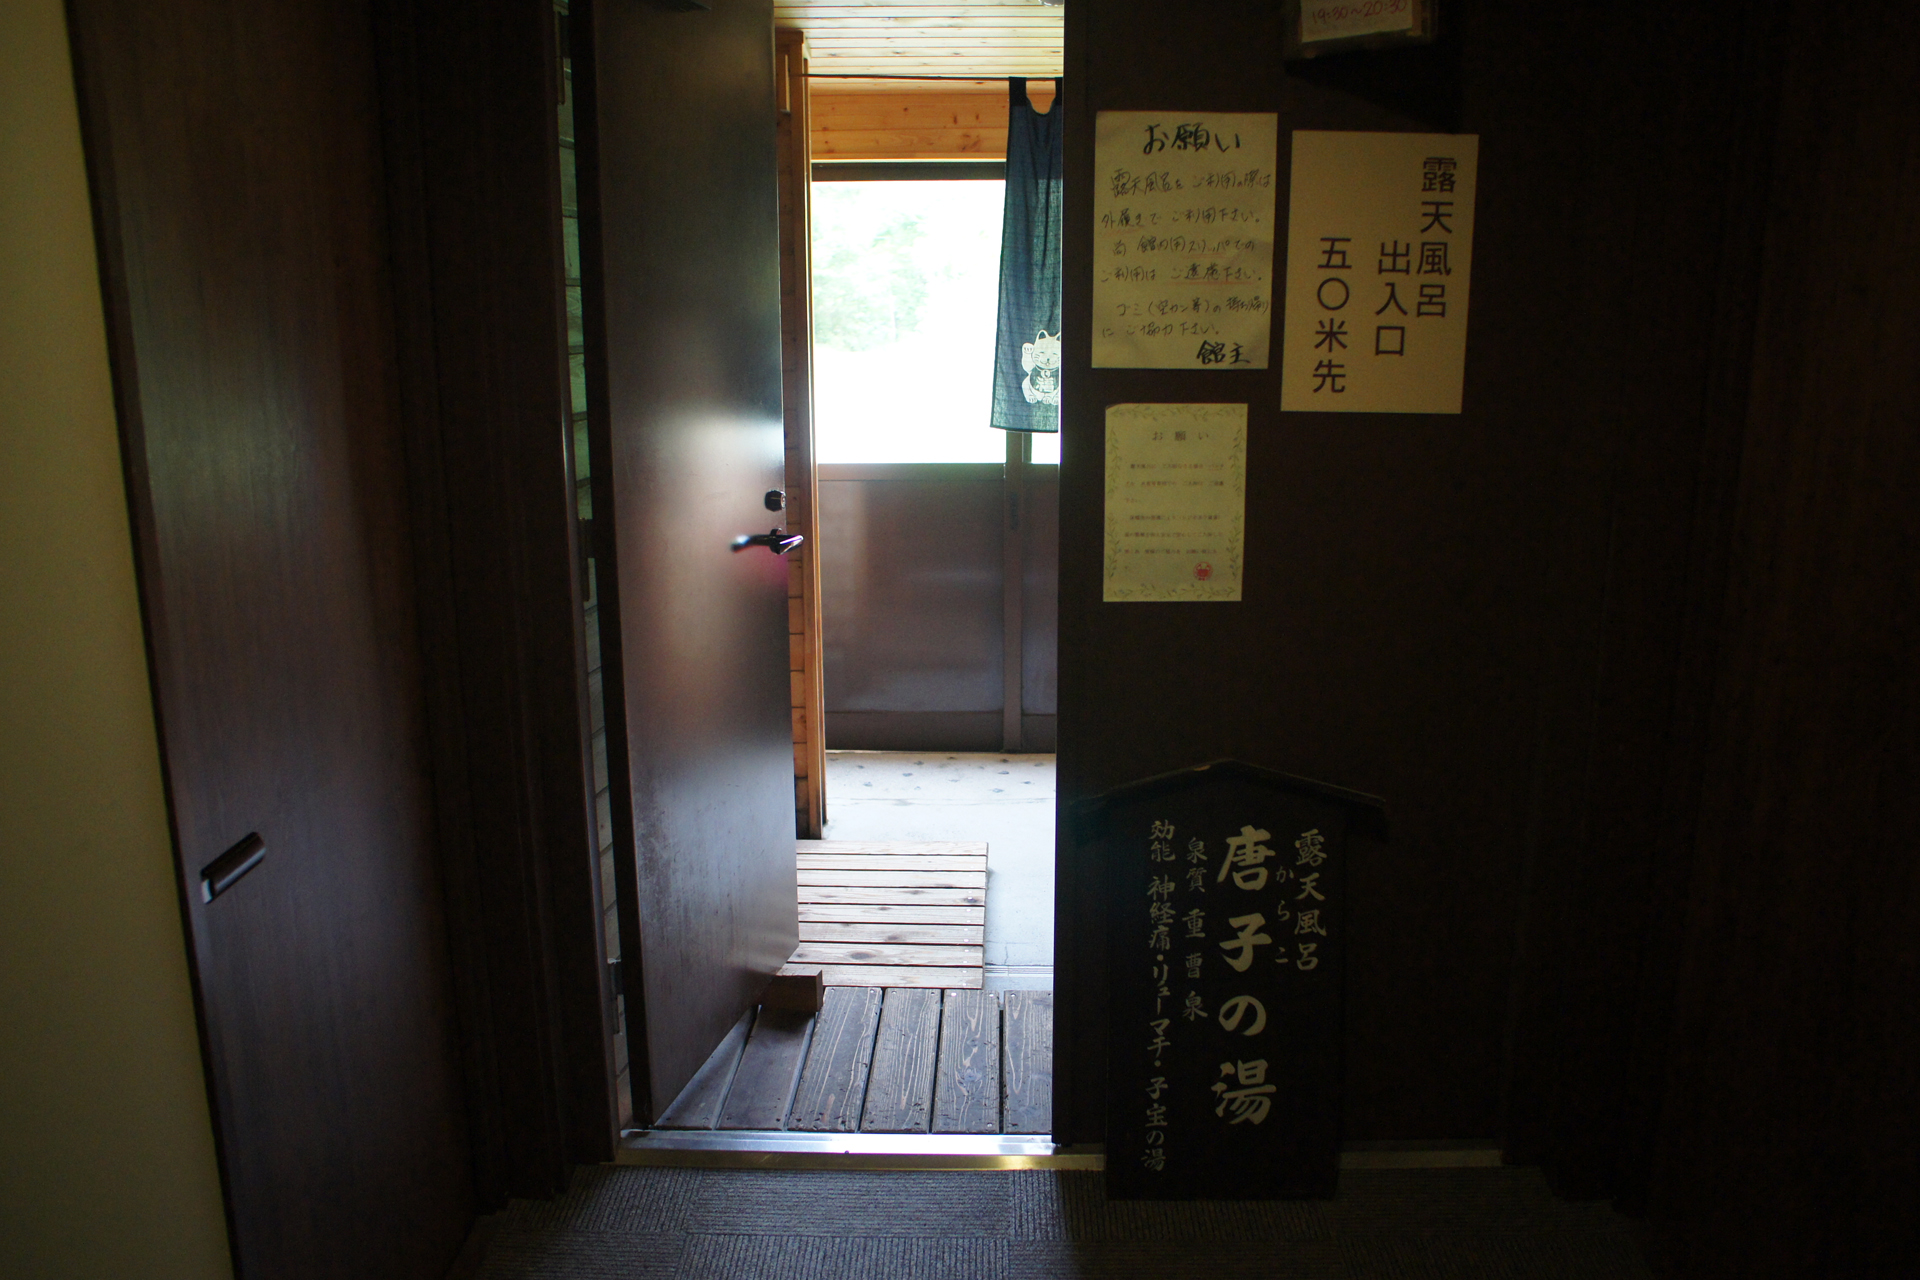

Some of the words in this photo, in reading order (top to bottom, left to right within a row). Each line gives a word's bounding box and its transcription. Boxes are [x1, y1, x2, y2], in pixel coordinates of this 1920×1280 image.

[1143, 123, 1242, 154] お願い
[1416, 156, 1458, 319] 露天風呂
[1196, 340, 1252, 365] 館主
[1312, 236, 1353, 394] 五〇米先
[1374, 239, 1411, 357] 出入口
[1148, 818, 1176, 863] 効能
[1184, 836, 1209, 894] 泉質
[1273, 864, 1295, 965] からこ
[1293, 828, 1328, 973] 露天風呂
[1181, 907, 1209, 1022] 重曹泉
[1210, 823, 1278, 1126] 唐子の湯
